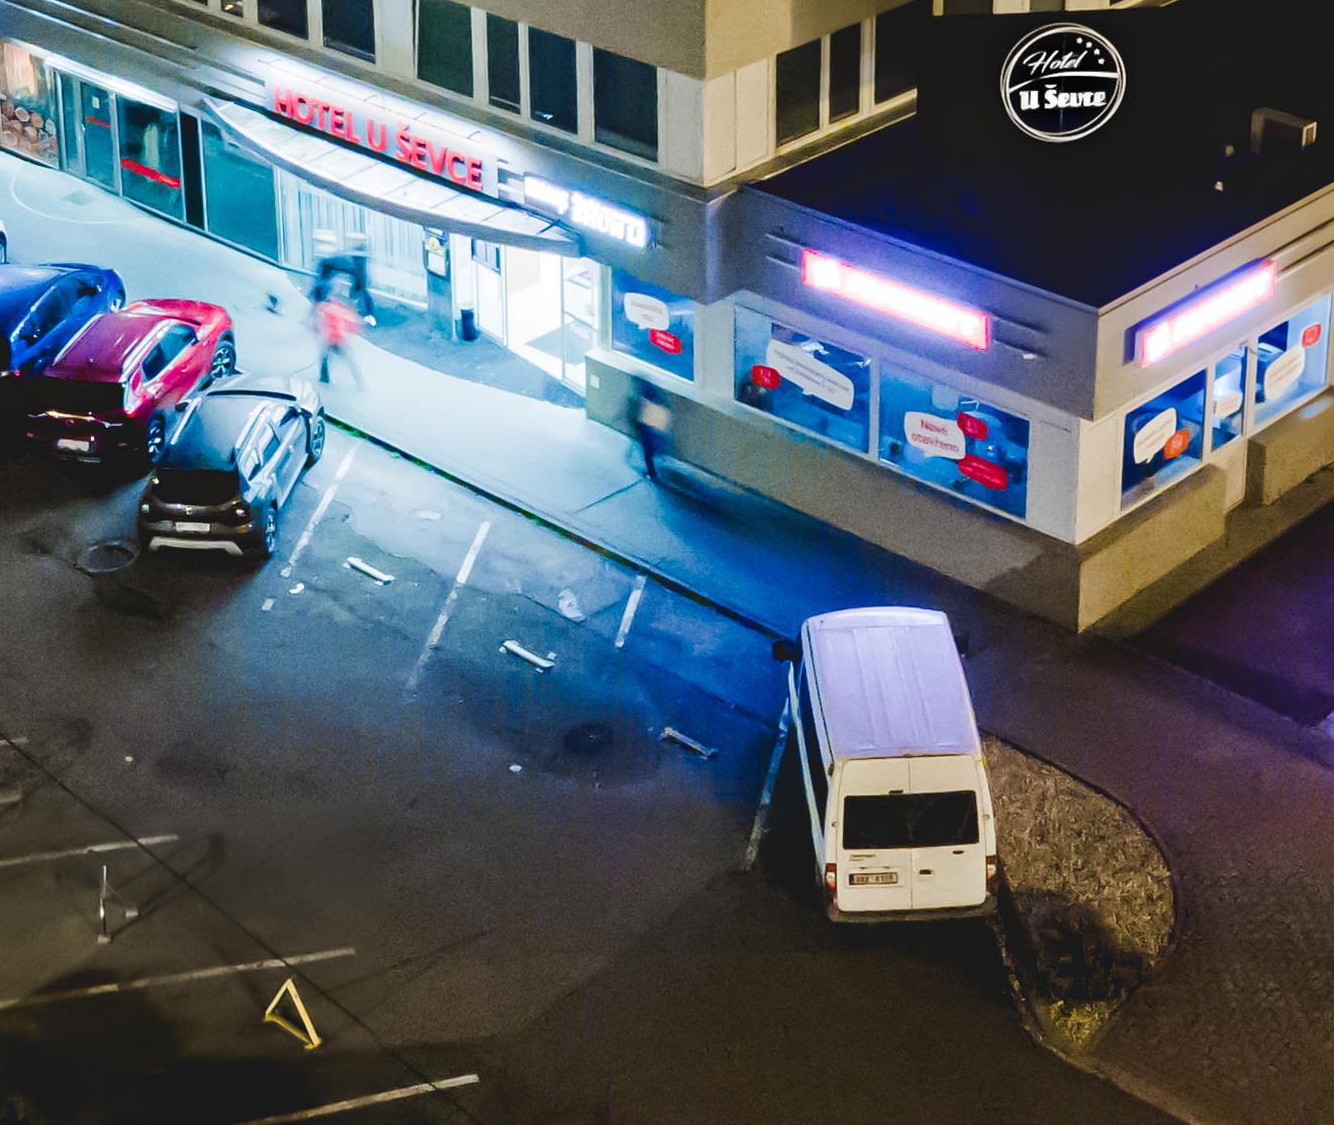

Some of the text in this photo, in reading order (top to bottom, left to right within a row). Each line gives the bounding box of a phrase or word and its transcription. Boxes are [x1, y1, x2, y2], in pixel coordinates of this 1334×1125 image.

[1023, 50, 1087, 75] Hotel
[273, 84, 484, 192] HOTEL U ŠEVCE
